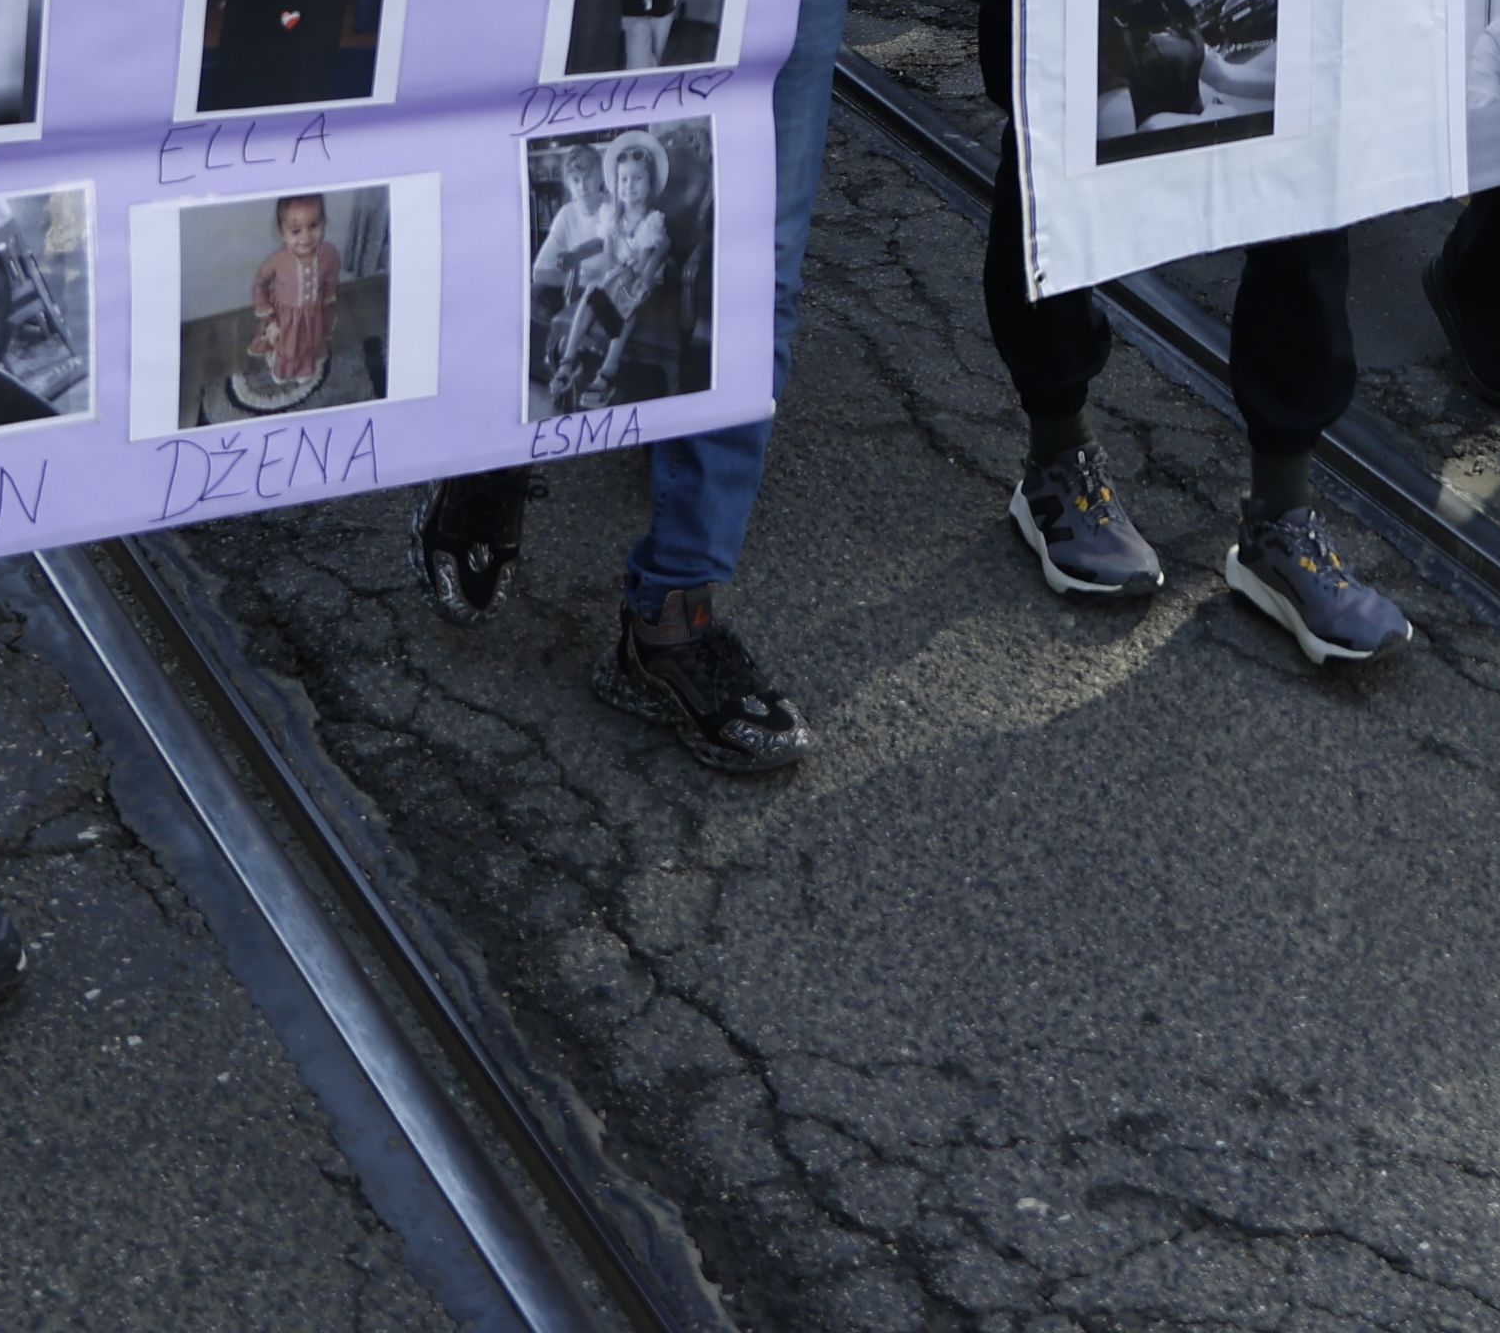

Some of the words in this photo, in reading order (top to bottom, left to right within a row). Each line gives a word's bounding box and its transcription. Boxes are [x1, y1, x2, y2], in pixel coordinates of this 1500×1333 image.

[517, 73, 690, 136] DŽEJLA
[154, 111, 335, 184] ELLA
[529, 408, 644, 461] ESMA
[152, 417, 377, 522] DŽENA
